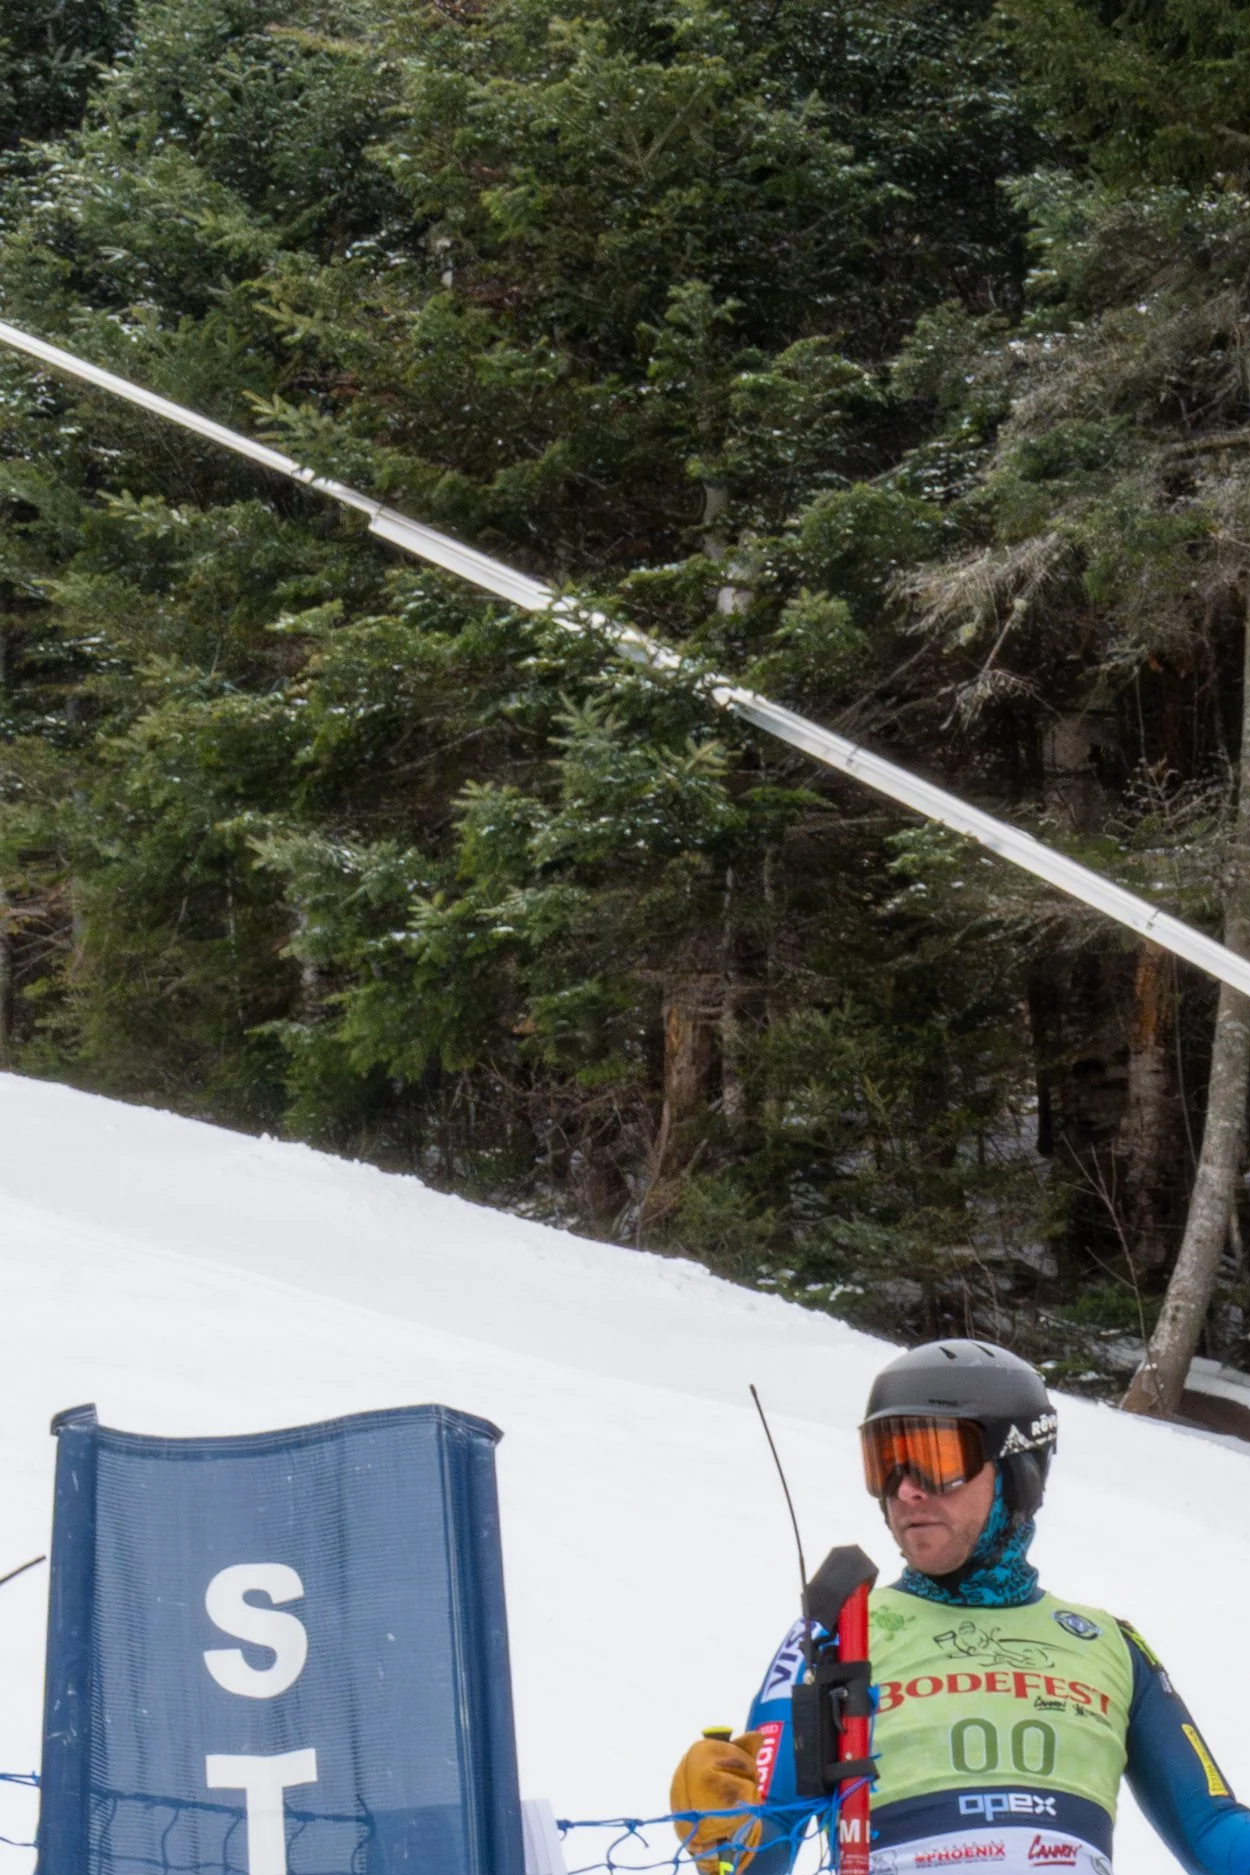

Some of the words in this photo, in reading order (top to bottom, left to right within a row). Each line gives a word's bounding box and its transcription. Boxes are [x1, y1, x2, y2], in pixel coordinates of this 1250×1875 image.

[875, 1671, 1111, 1717] BODEFEST
[950, 1718, 1056, 1776] 00
[926, 1844, 1006, 1862] PHOENIX
